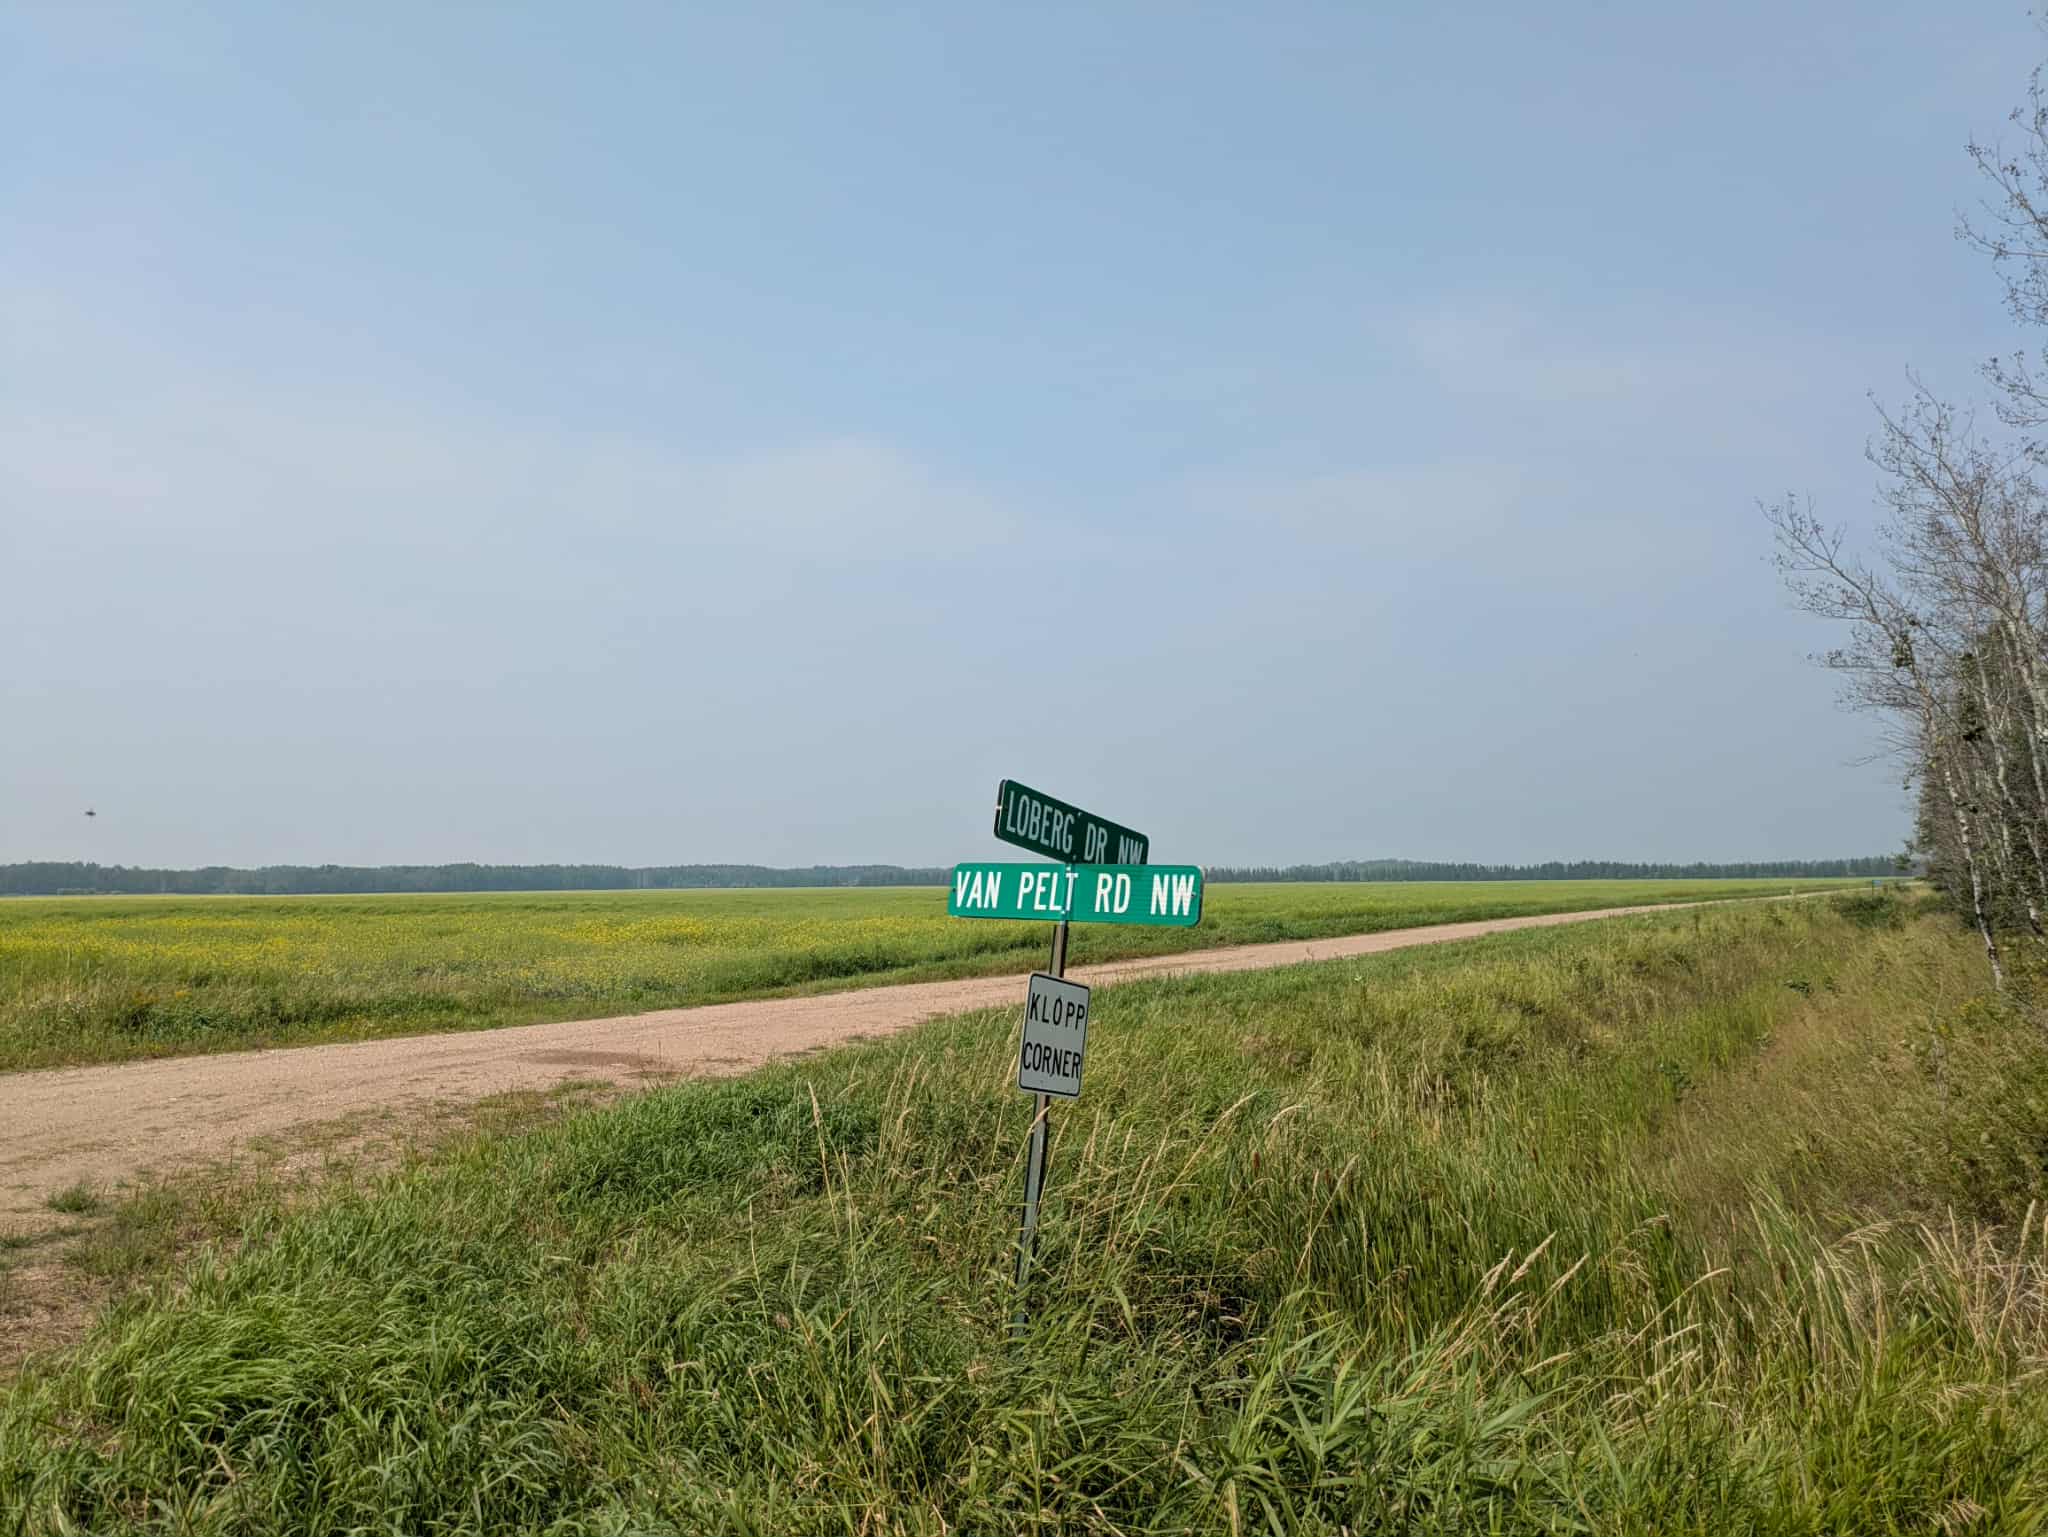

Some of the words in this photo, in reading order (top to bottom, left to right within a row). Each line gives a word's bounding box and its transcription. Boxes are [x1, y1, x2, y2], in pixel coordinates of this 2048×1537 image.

[1006, 790, 1075, 853] LOBERG
[1084, 822, 1108, 864] DR
[1117, 835, 1144, 864] NW
[956, 871, 1002, 909] VAN
[1016, 872, 1079, 911] PELT
[1094, 873, 1131, 914] RD
[1150, 874, 1195, 916] NW
[1030, 992, 1086, 1030] KLOPP
[1023, 1041, 1081, 1079] CORNER
